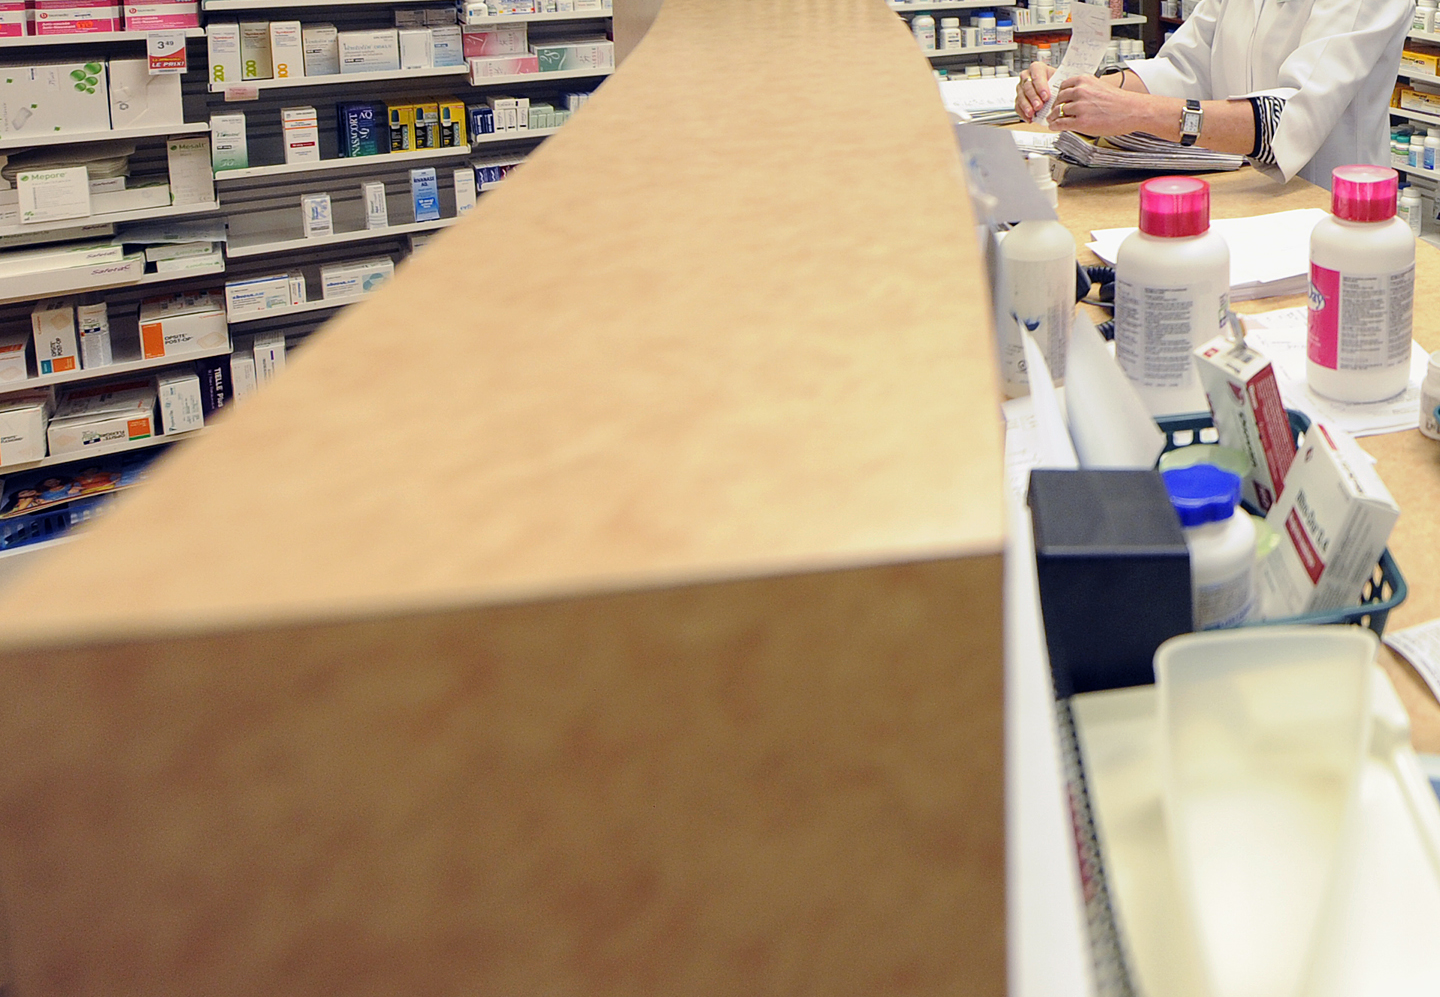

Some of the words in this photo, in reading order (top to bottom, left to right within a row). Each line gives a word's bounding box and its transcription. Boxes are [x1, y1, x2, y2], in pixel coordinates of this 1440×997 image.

[157, 41, 165, 49] 3
[213, 65, 225, 82] 200
[246, 60, 257, 77] 200
[278, 63, 288, 78] 100
[31, 172, 66, 182] Mepore
[165, 333, 188, 341] OPSITE
[165, 337, 193, 345] POST-OP
